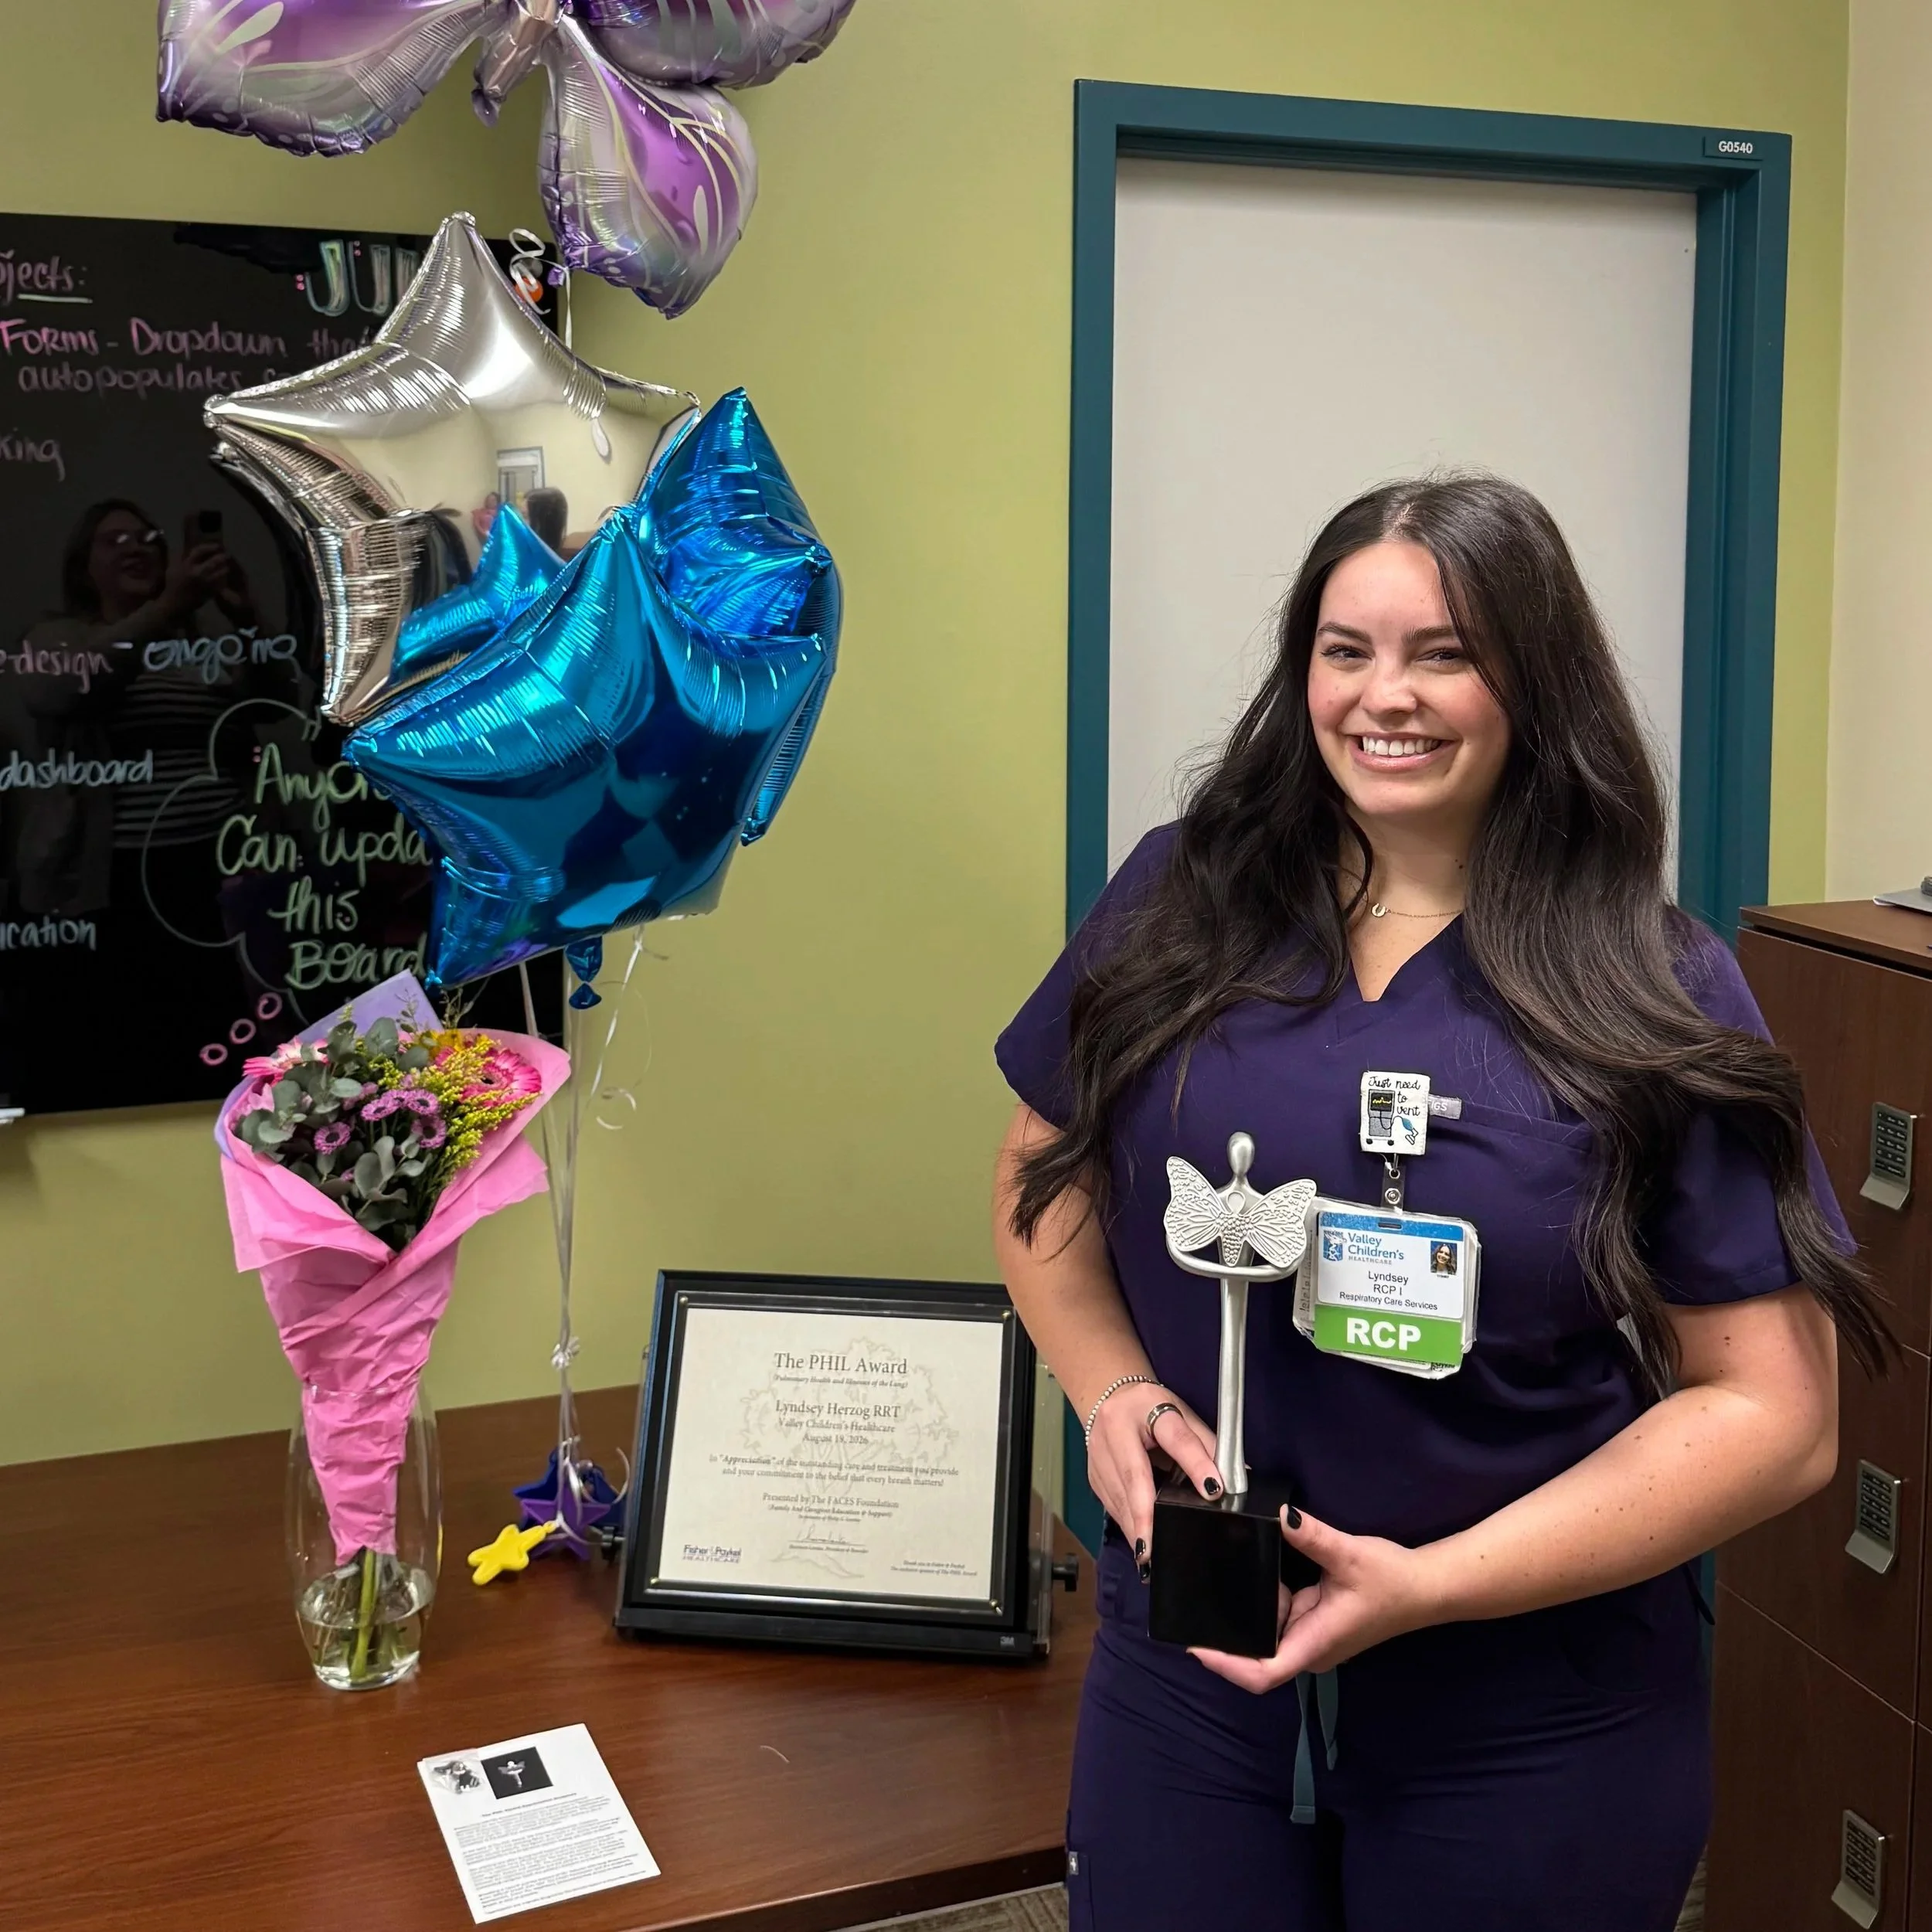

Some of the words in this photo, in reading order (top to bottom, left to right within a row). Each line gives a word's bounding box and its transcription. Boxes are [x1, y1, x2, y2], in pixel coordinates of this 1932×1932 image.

[1718, 141, 1753, 154] G0540
[130, 317, 287, 360] Dropdown
[144, 626, 301, 683] ongoing
[0, 747, 153, 791] dashboard
[216, 815, 297, 875] Can
[321, 813, 433, 887] upda
[267, 875, 359, 934] this
[1368, 1076, 1391, 1088] Just
[1396, 1080, 1420, 1090] need
[1397, 1091, 1407, 1104] to
[1397, 1106, 1420, 1116] vent
[1348, 1232, 1382, 1247] Valley
[1348, 1244, 1404, 1260] Children's
[1349, 1256, 1392, 1265] HEALTHCARE
[1369, 1271, 1408, 1285] Lyndsey
[1374, 1284, 1396, 1294] RCP
[1339, 1292, 1383, 1304] Respiratory
[1384, 1297, 1403, 1306] Care
[1405, 1299, 1437, 1310] Services
[1347, 1317, 1421, 1351] RCP
[774, 1352, 804, 1369] The
[809, 1354, 850, 1371] PHIL
[855, 1357, 906, 1374] Award
[776, 1400, 824, 1417] Lyndsey
[828, 1403, 870, 1420] Herzog
[873, 1404, 901, 1418] RRT
[778, 1417, 804, 1429] Valley
[806, 1419, 849, 1430] Children's
[851, 1421, 895, 1432] Healthcare
[803, 1433, 832, 1444] August
[763, 1492, 799, 1502] Presented
[828, 1496, 855, 1505] FACES
[856, 1498, 899, 1508] Foundation
